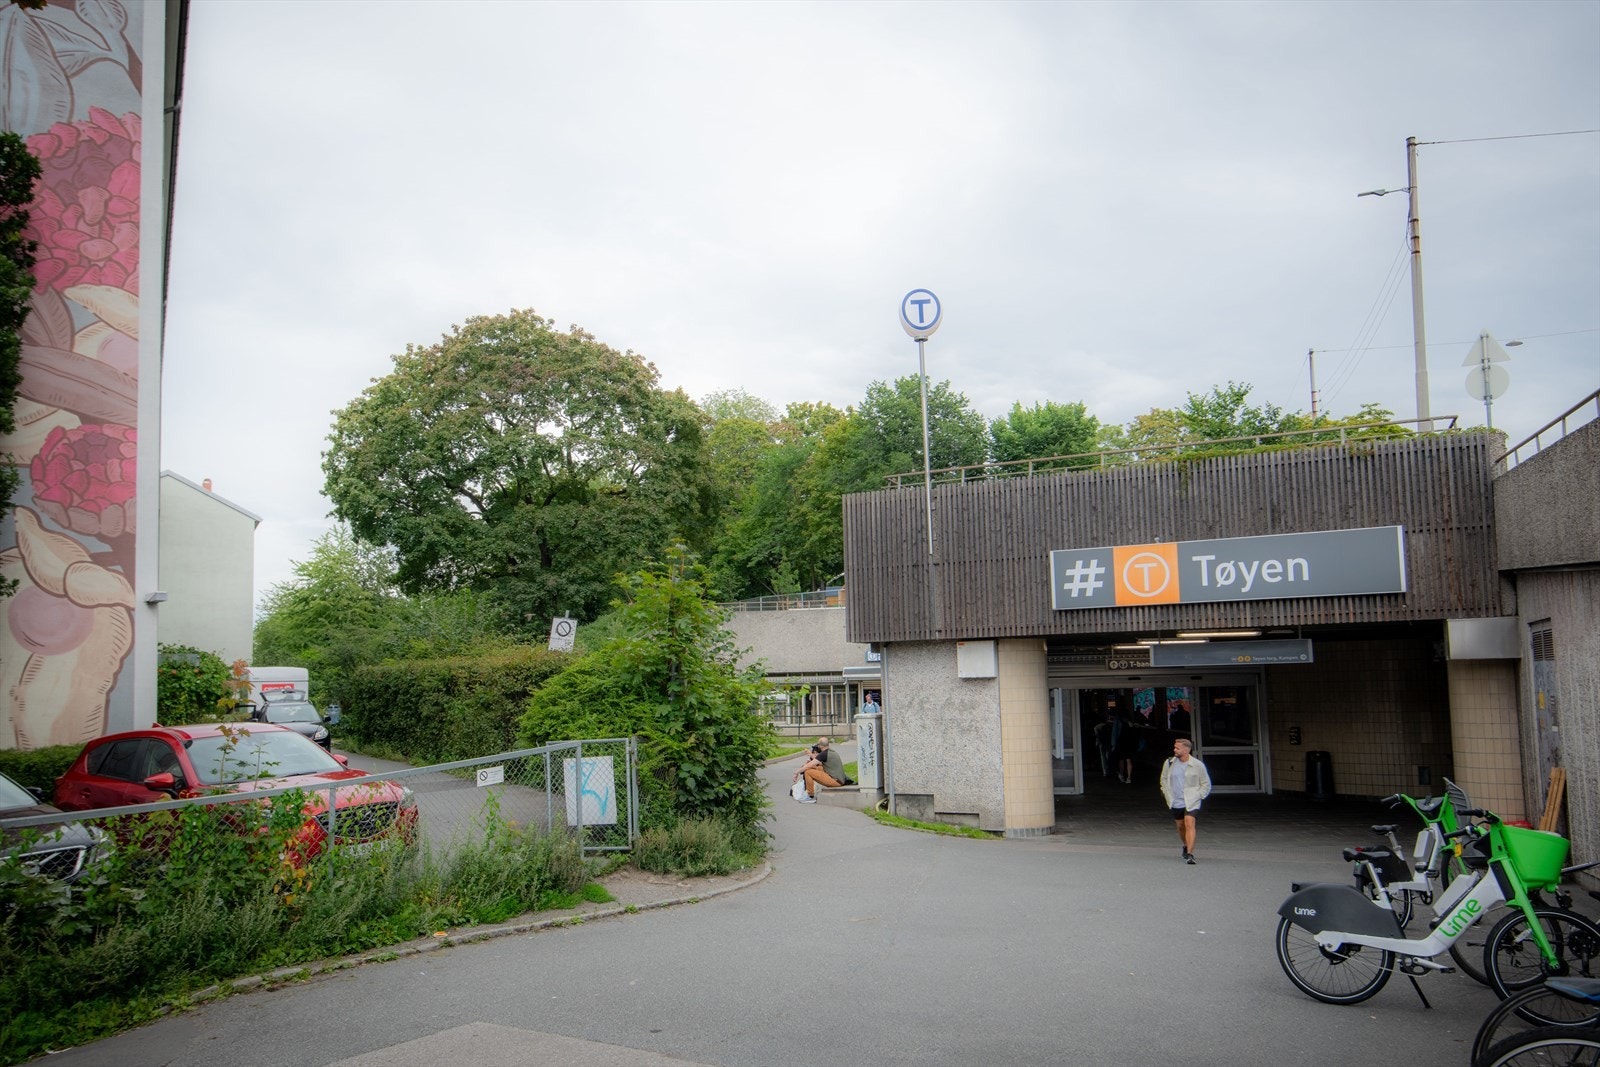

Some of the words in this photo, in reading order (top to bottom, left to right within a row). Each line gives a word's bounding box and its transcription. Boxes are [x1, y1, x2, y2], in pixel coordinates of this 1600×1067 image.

[910, 299, 931, 323] T
[1134, 562, 1158, 592] T
[1192, 555, 1310, 593] Tøyen
[1439, 899, 1482, 937] Lime
